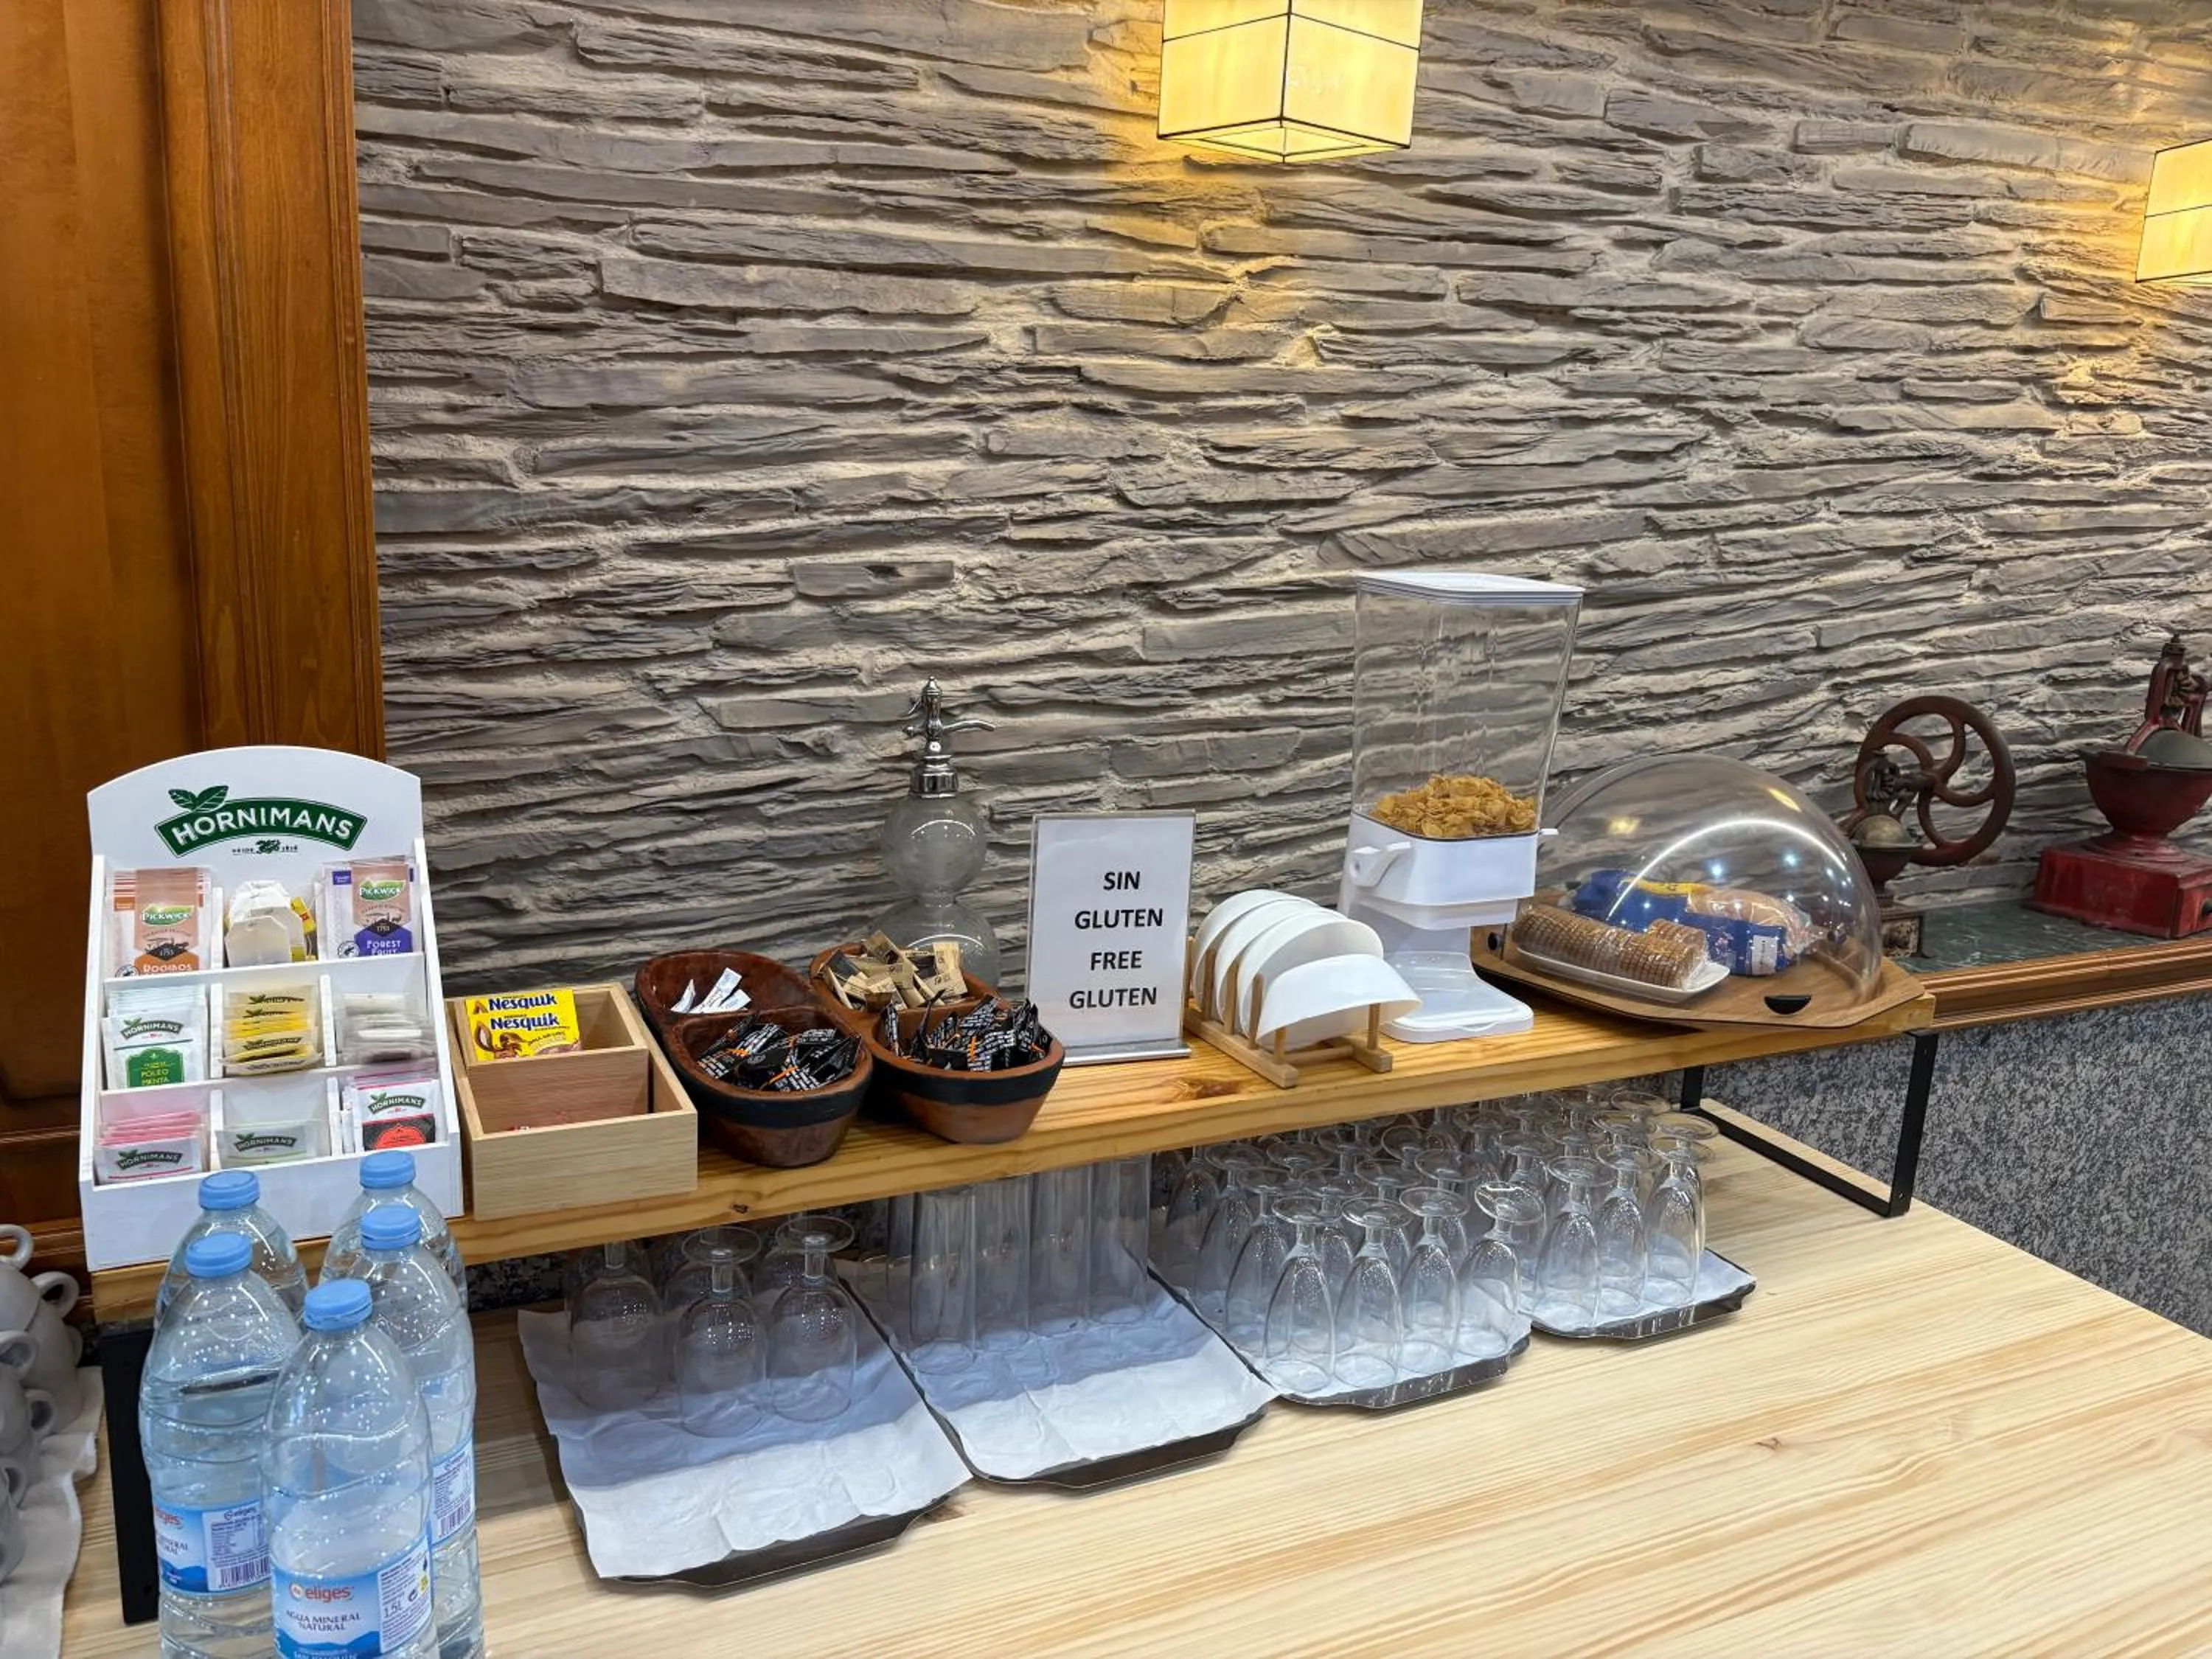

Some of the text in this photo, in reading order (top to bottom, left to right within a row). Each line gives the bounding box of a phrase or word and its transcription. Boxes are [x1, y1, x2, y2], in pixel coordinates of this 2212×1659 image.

[171, 807, 353, 845] HORNIMANS
[1103, 872, 1140, 891] SIN
[360, 887, 400, 897] PICKWICK
[142, 911, 190, 922] PICKWICK
[1074, 908, 1163, 930] GLUTEN
[1091, 950, 1142, 970] FREE
[488, 994, 557, 1011] Nesquik
[1070, 987, 1157, 1009] GLUTEN
[490, 1013, 560, 1031] Nesquik
[124, 1023, 179, 1037] HORNIMANS
[371, 1098, 422, 1111] HORNIMANS
[237, 1136, 293, 1150] HORNIMANS
[120, 1154, 179, 1168] HORNIMANS
[305, 1585, 351, 1603] eliges
[287, 1610, 361, 1624] AGUA MINERAL
[299, 1623, 346, 1632] NATURAL
